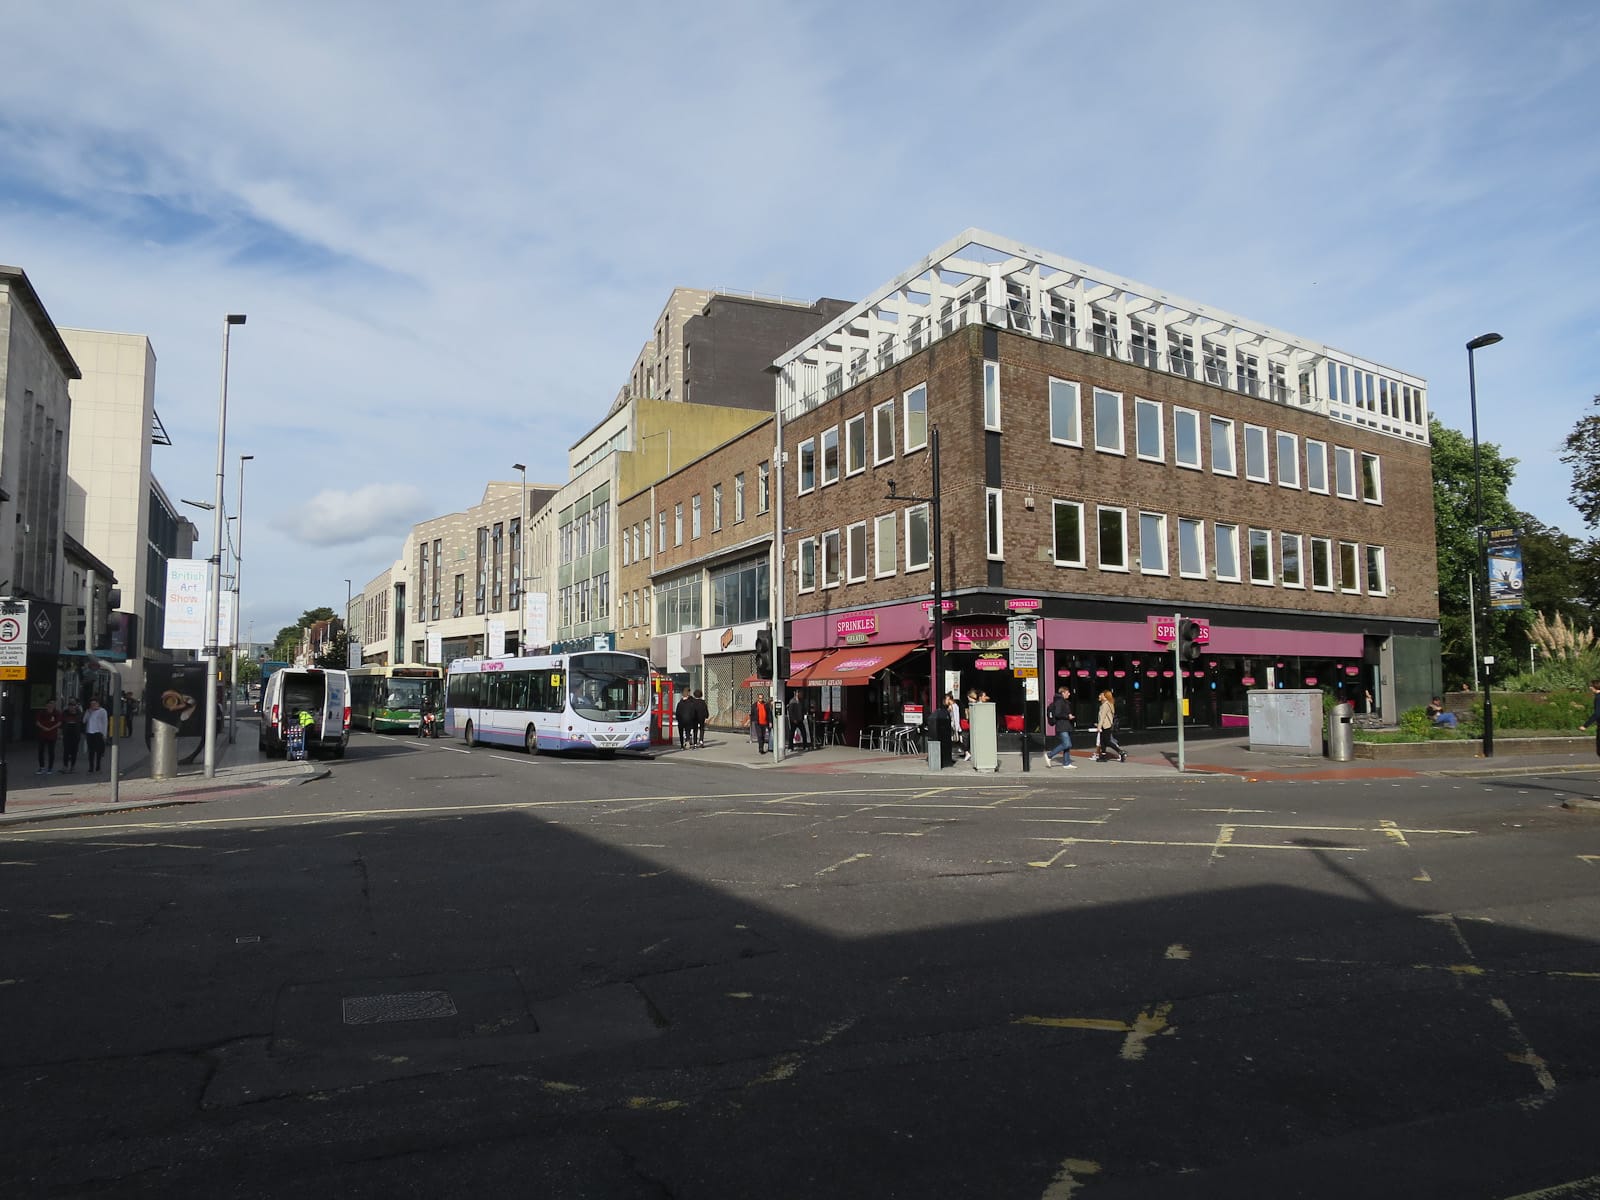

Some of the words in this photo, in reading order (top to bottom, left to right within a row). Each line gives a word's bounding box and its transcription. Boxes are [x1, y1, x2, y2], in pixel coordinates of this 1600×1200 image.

[171, 571, 205, 580] British
[180, 583, 197, 592] Art
[169, 593, 199, 603] Show
[837, 618, 875, 632] SPRINKLES
[846, 634, 865, 642] GELATO
[974, 640, 1009, 648] GELATO
